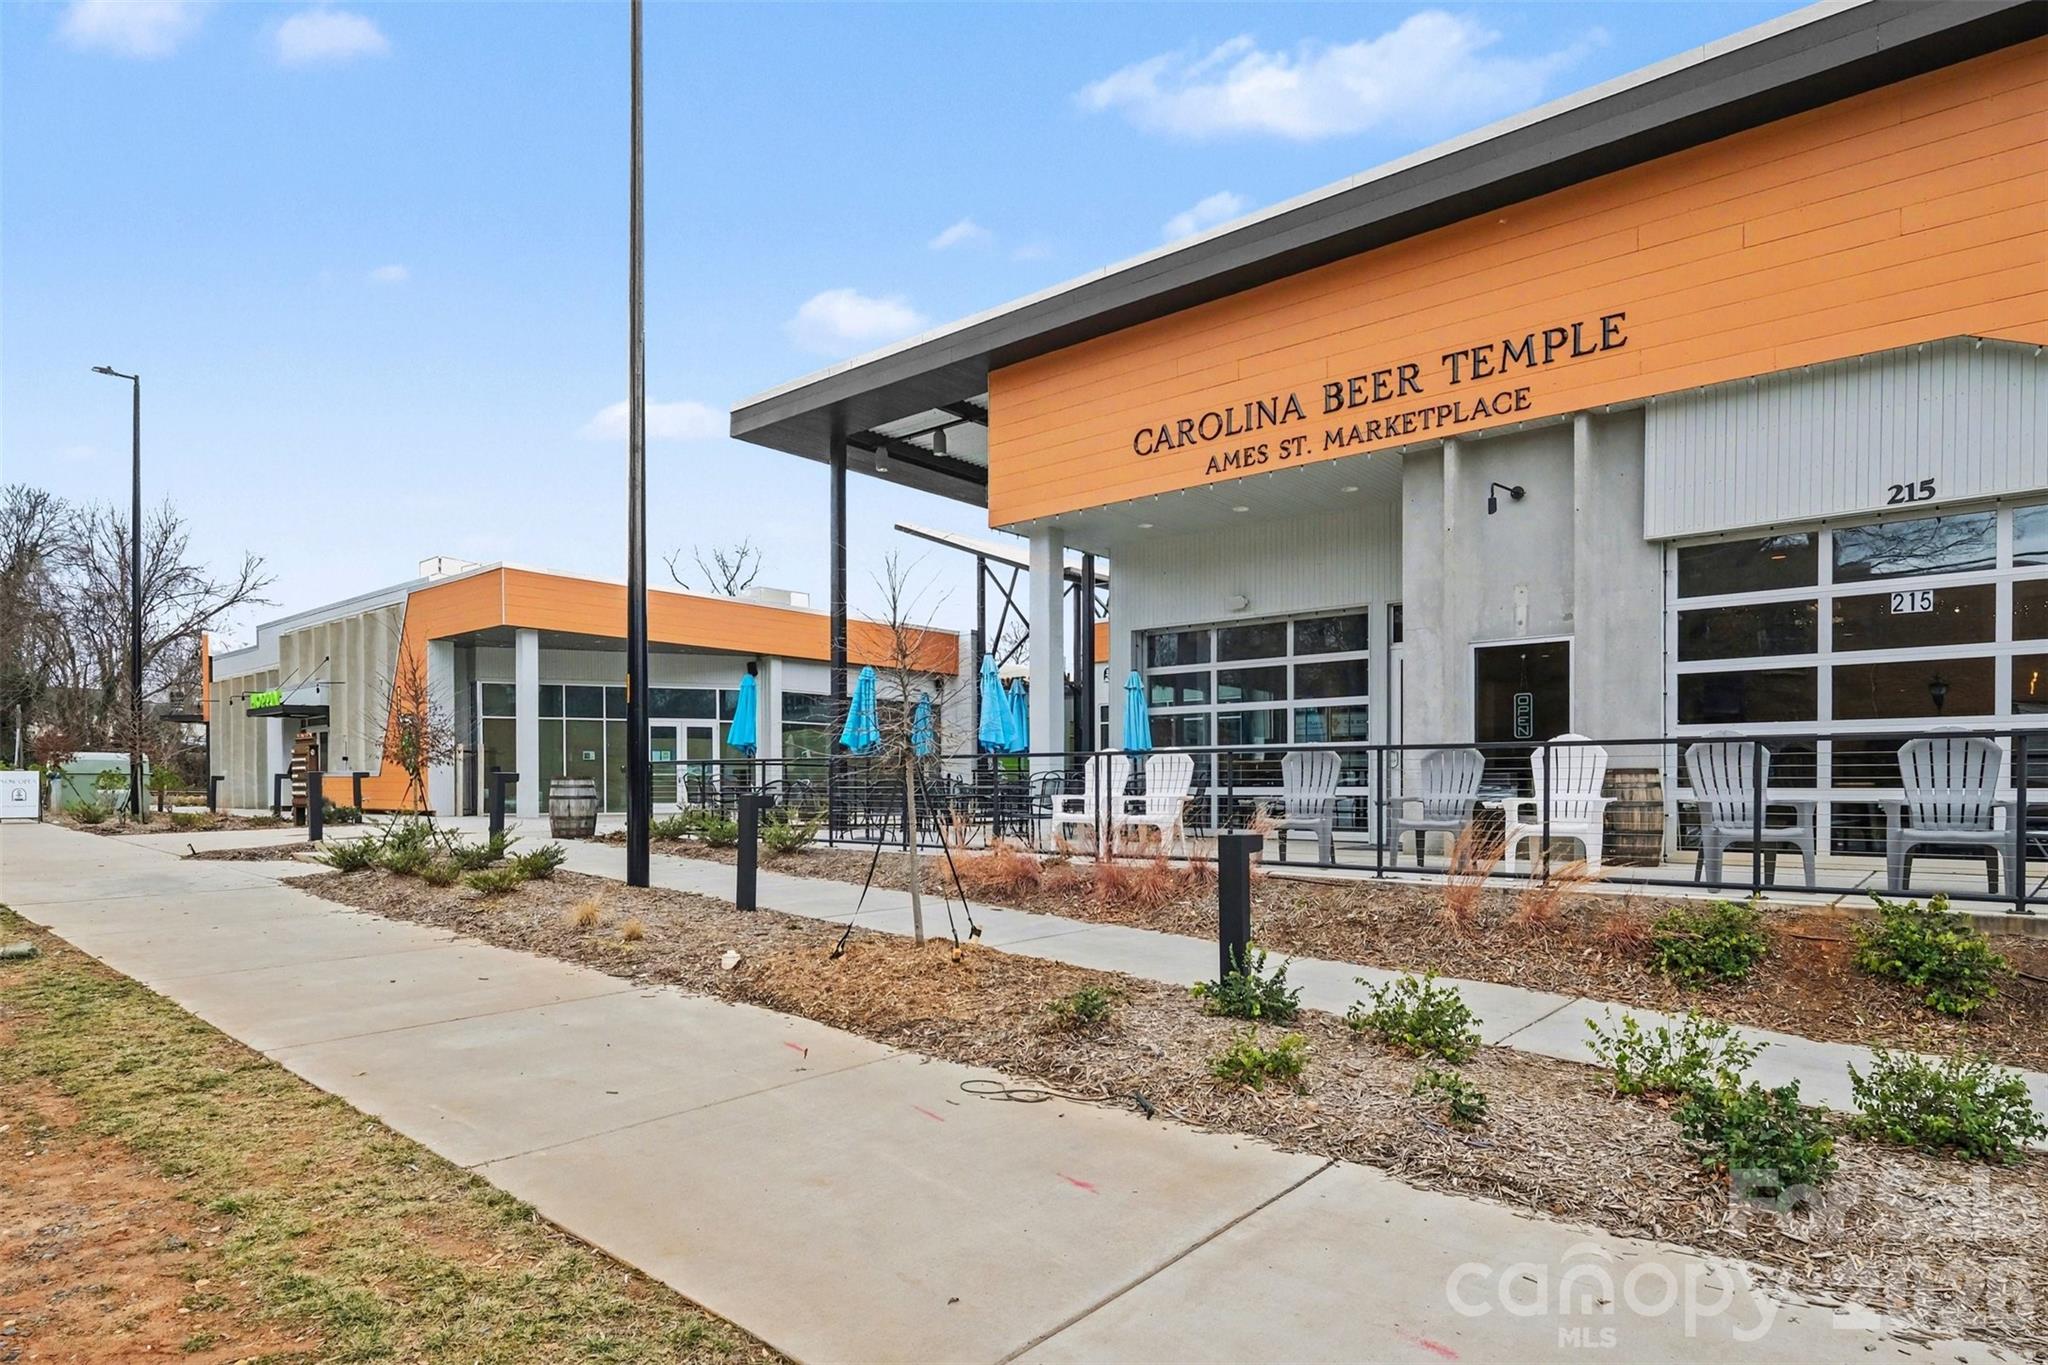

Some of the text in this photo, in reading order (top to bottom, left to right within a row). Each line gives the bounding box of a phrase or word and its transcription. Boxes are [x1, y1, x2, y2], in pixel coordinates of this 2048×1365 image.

[1133, 311, 1628, 457] CAROLINA BEER TEMPLE
[1205, 387, 1532, 475] AMES ST. MARKETPLACE
[1887, 478, 1936, 505] 215
[1892, 591, 1932, 612] 215
[1517, 696, 1530, 736] OPEN
